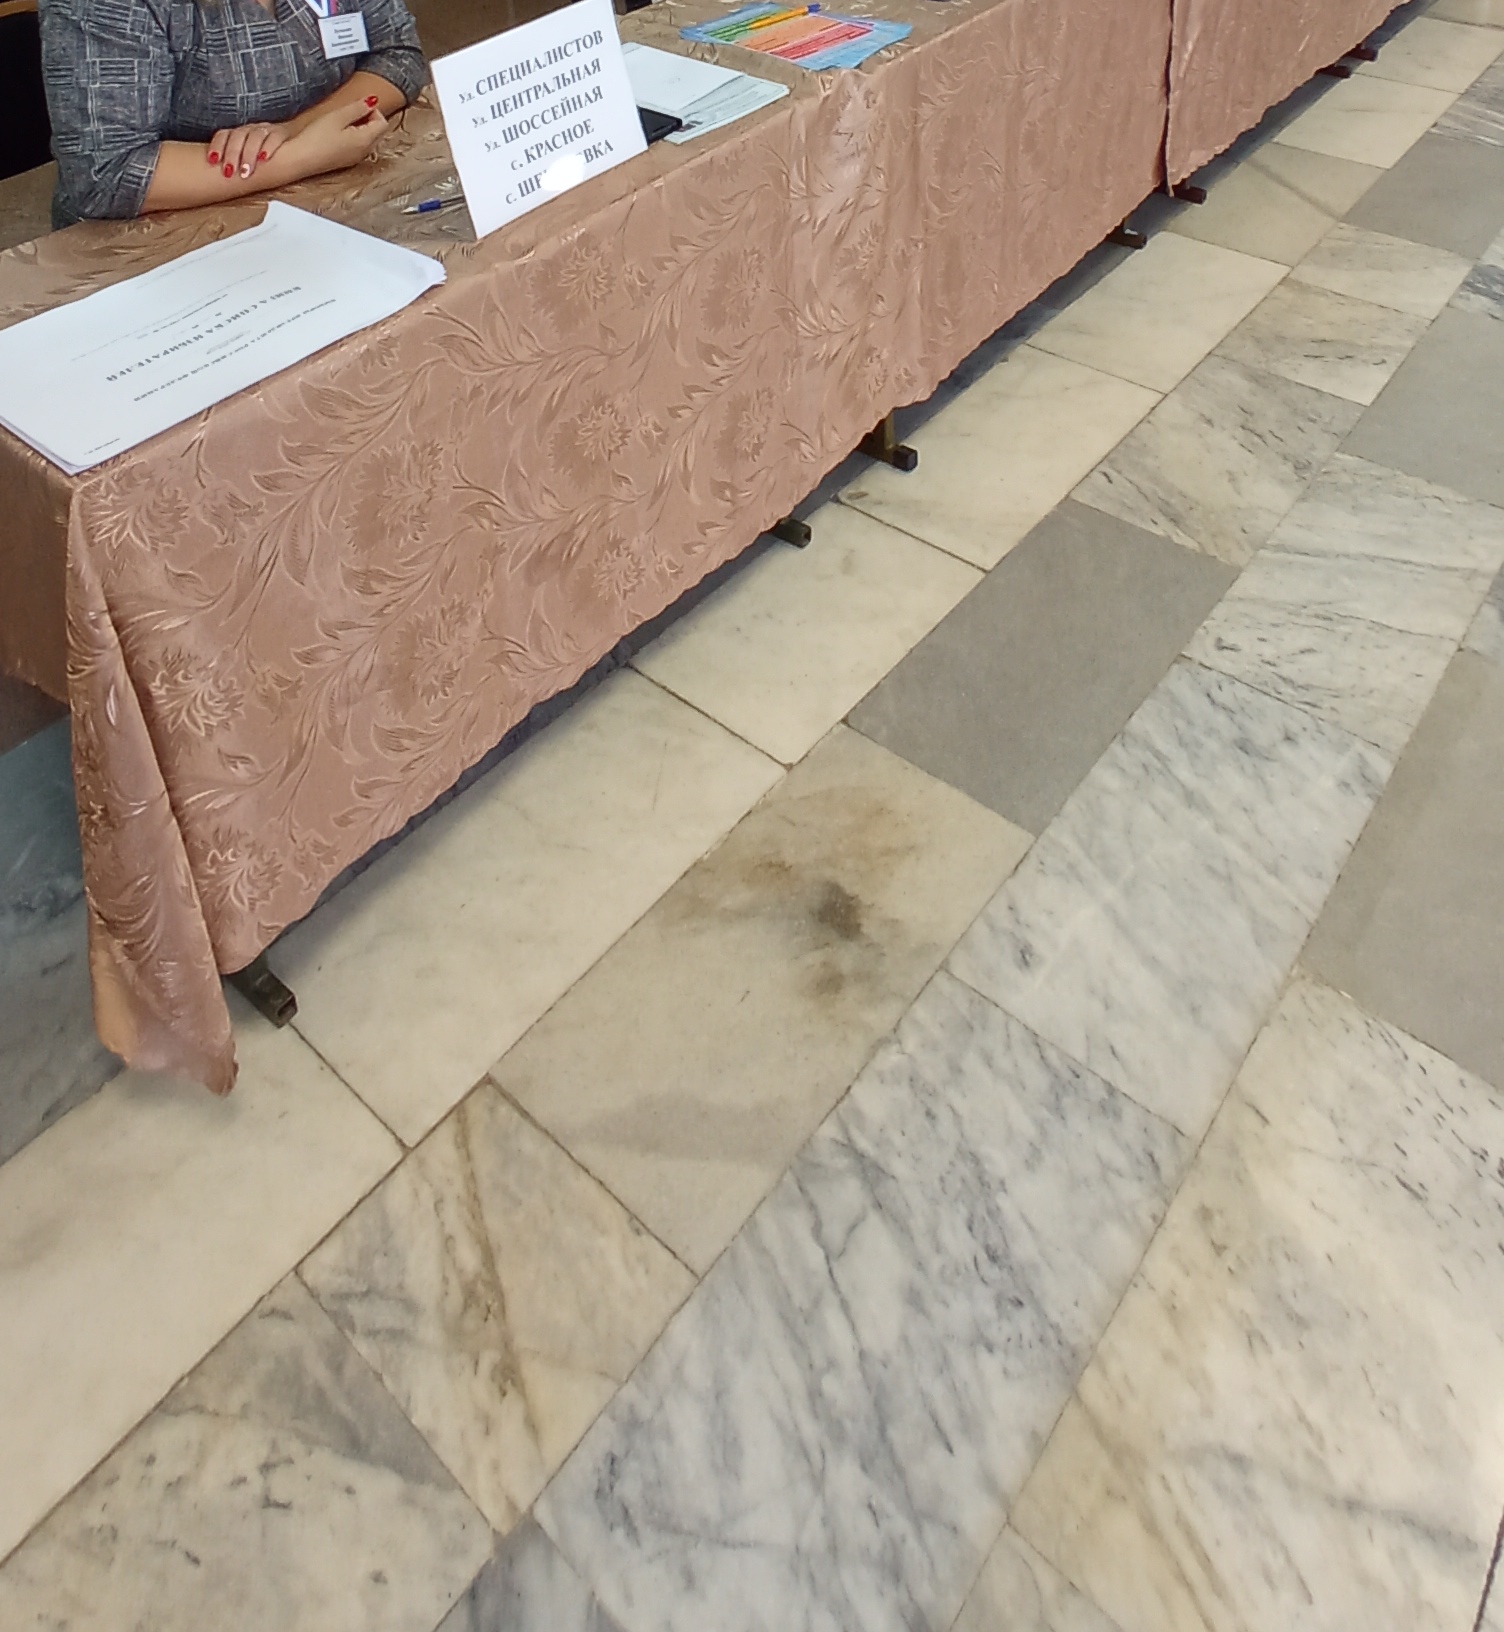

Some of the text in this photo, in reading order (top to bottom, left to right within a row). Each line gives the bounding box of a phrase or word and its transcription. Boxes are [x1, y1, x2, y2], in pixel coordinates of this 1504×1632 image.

[475, 30, 603, 96] СПЕЦИАЛИСТОВ
[490, 58, 602, 120] ЦЕНТРАЛЬНАЯ
[502, 85, 604, 144] ШОССЕЙНАЯ
[524, 119, 595, 164] КРАСНОЕ
